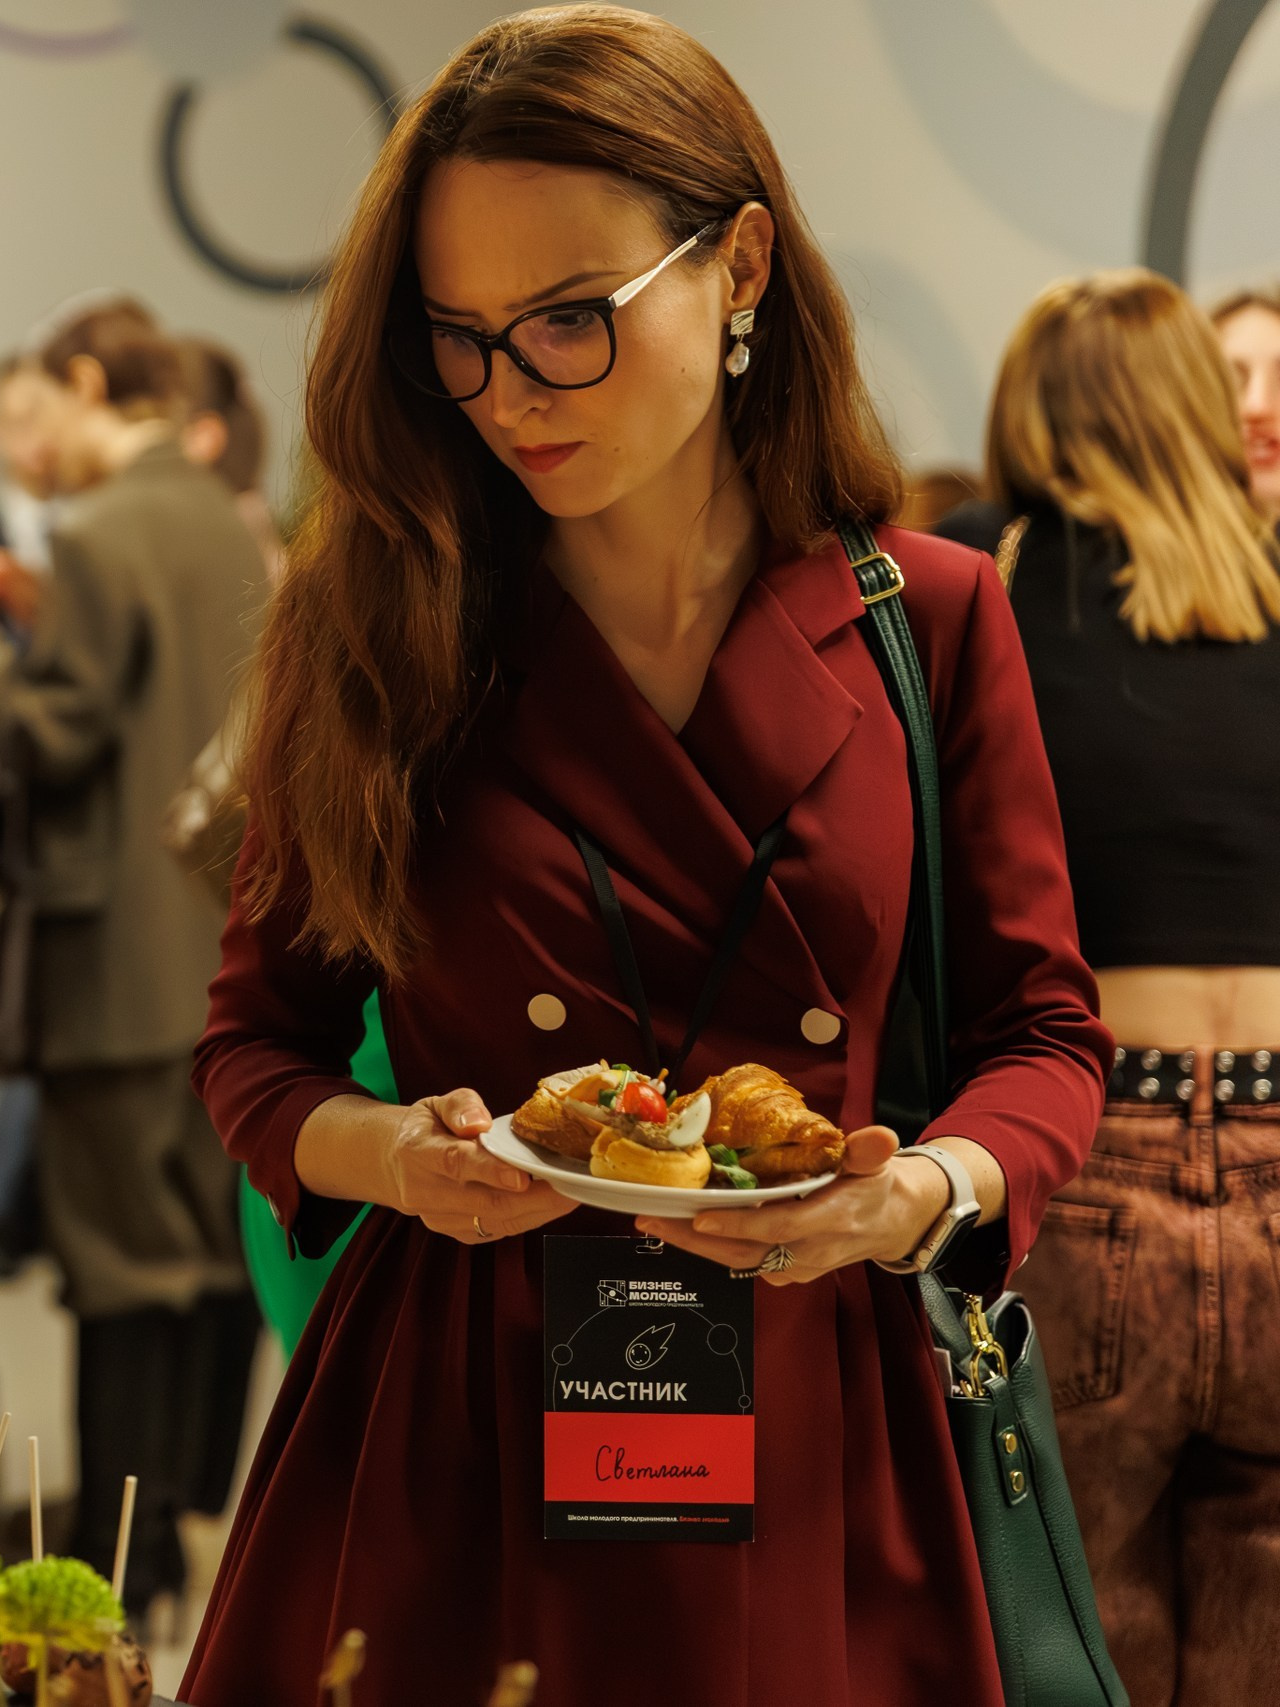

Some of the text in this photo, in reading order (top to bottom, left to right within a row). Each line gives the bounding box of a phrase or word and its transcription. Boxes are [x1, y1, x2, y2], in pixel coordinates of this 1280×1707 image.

[629, 1281, 682, 1290] БИЗНЕС
[629, 1291, 697, 1302] МОЛОДЫХ
[560, 1380, 688, 1402] УЧАСТНИК
[595, 1445, 710, 1482] Светлана
